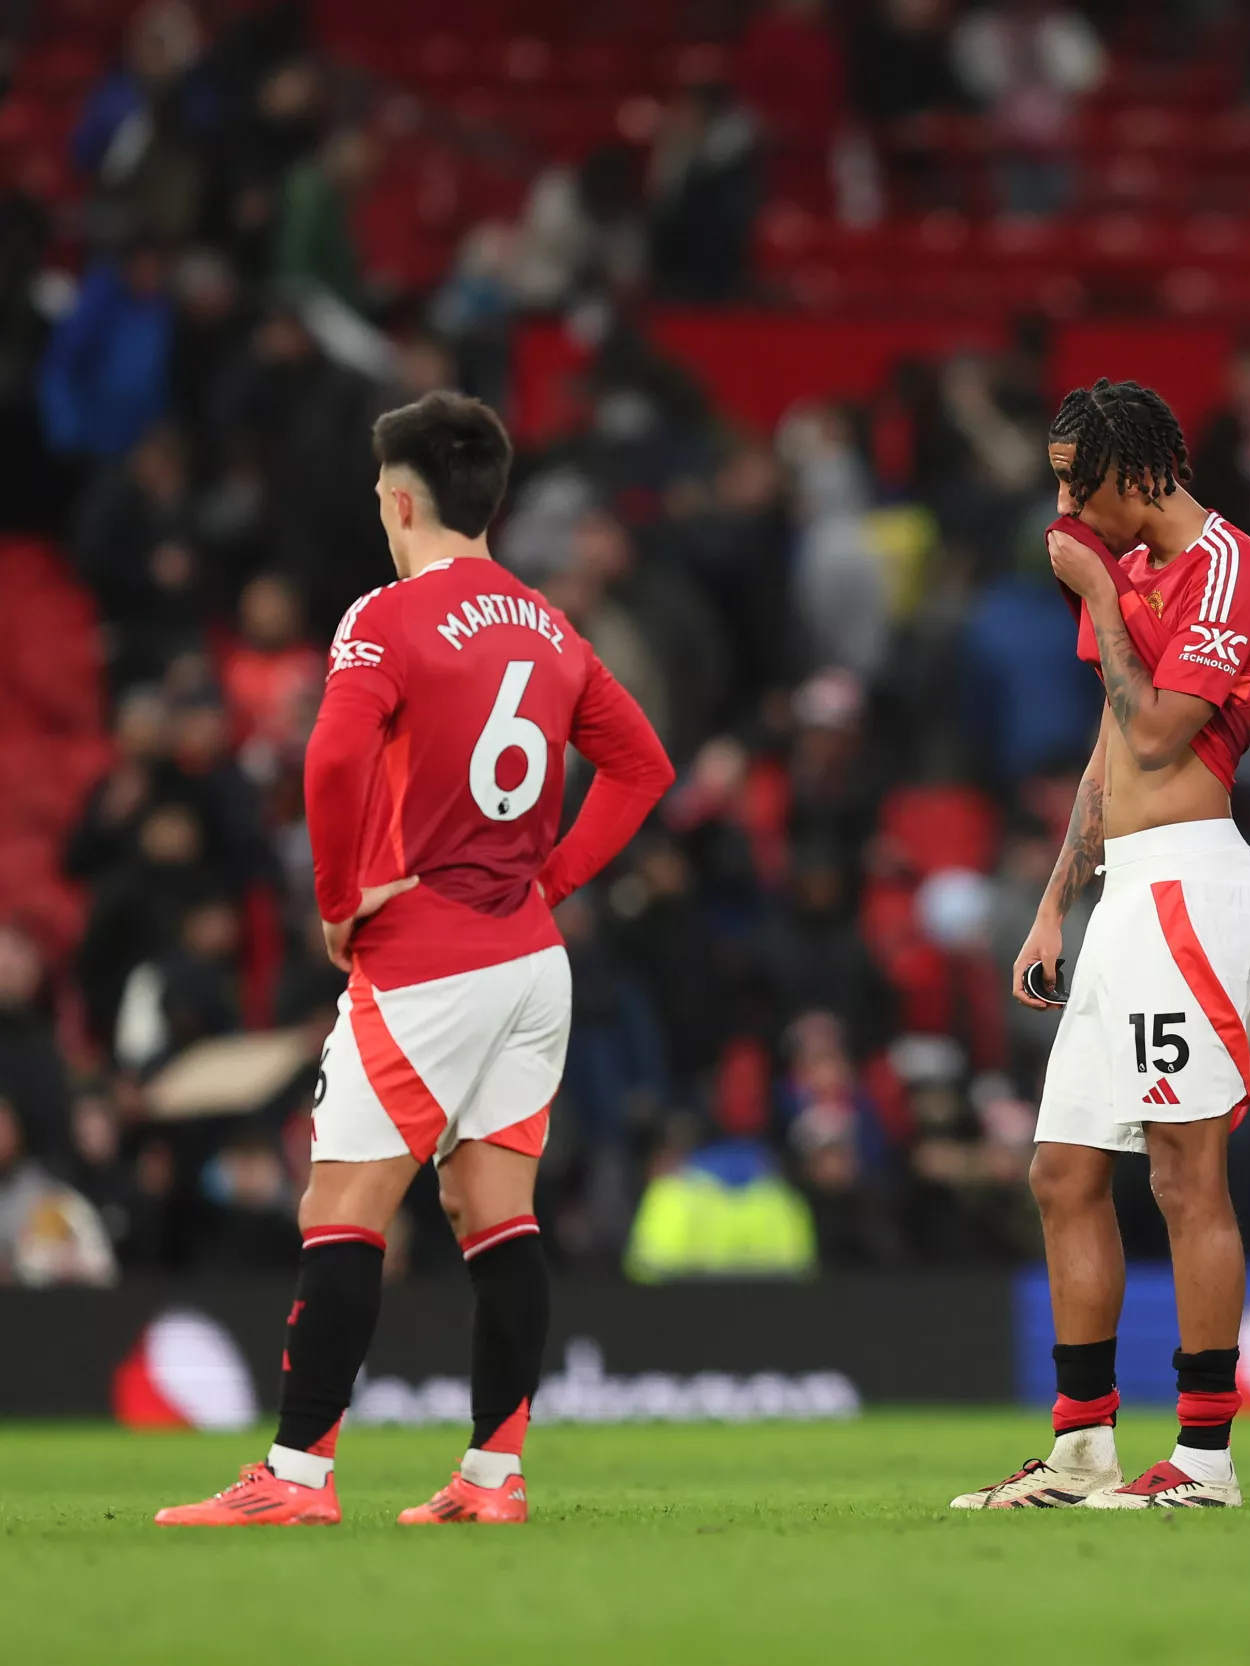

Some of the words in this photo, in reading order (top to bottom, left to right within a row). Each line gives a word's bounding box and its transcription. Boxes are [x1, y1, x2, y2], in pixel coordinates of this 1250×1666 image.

[437, 593, 565, 654] MARTINEZ
[1183, 624, 1249, 667] DXC
[469, 660, 548, 822] 6
[1129, 1012, 1190, 1074] 15
